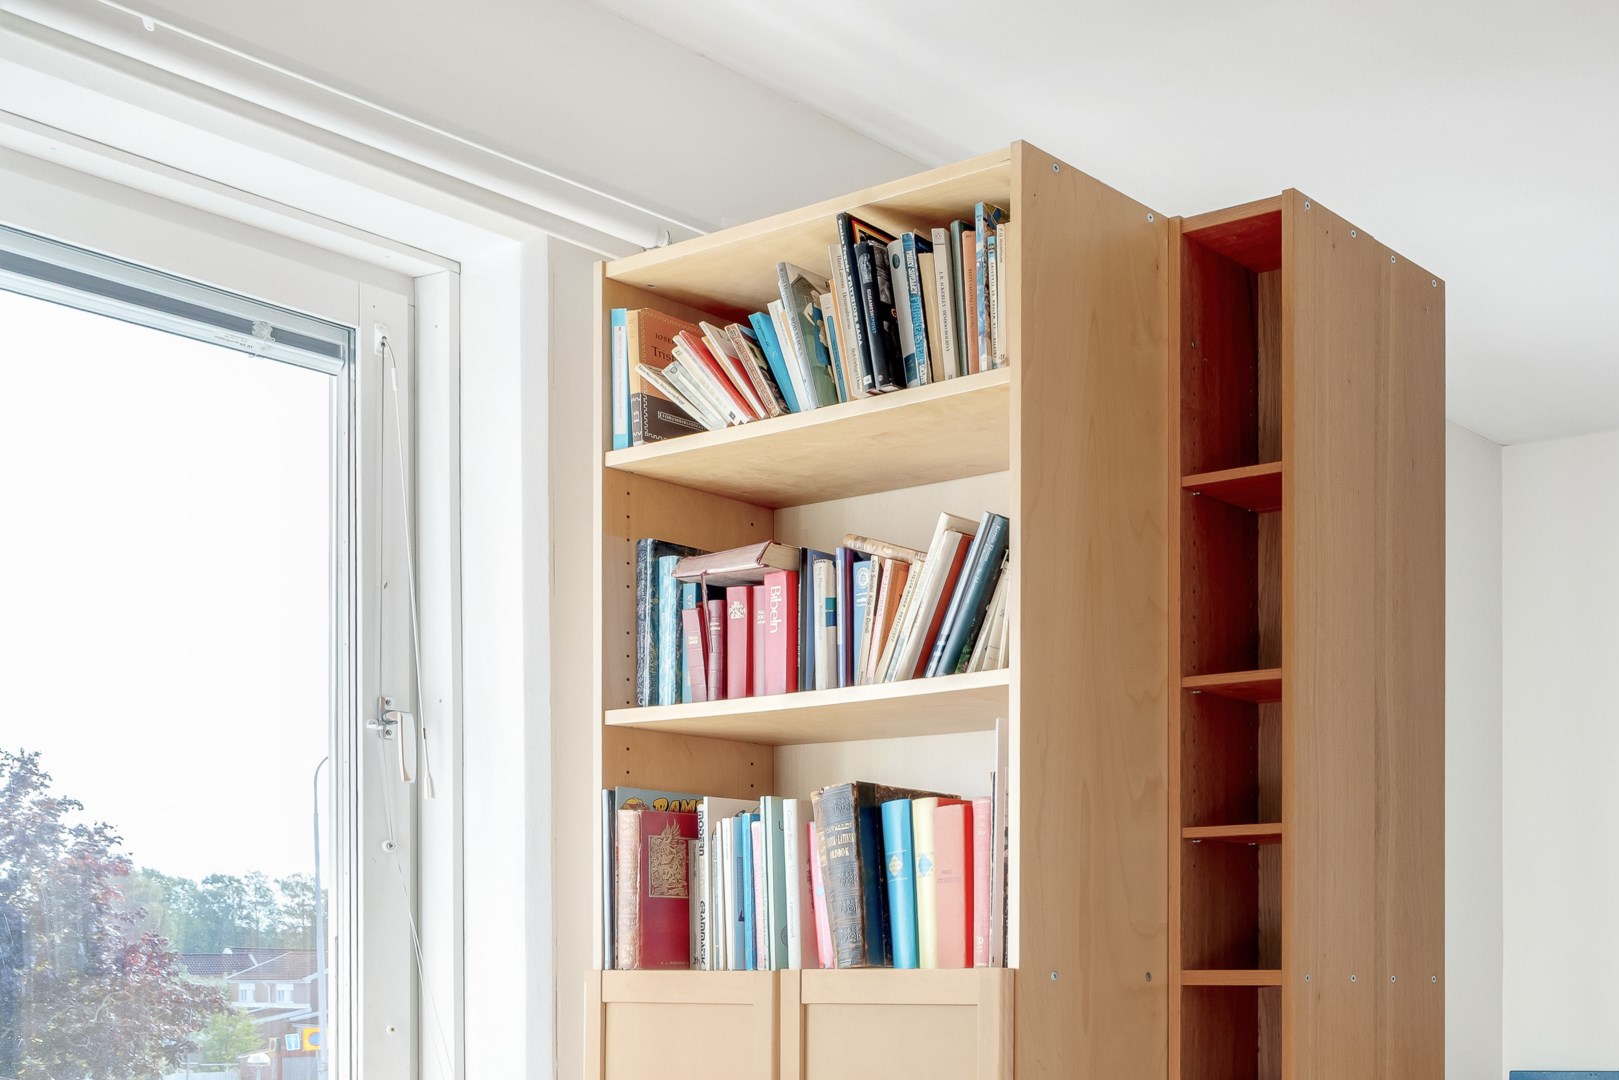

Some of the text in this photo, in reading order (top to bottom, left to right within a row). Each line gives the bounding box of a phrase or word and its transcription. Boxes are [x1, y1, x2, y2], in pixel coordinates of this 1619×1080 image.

[655, 333, 673, 344] JOSE
[769, 586, 782, 634] Bibeln
[653, 797, 704, 813] BAM
